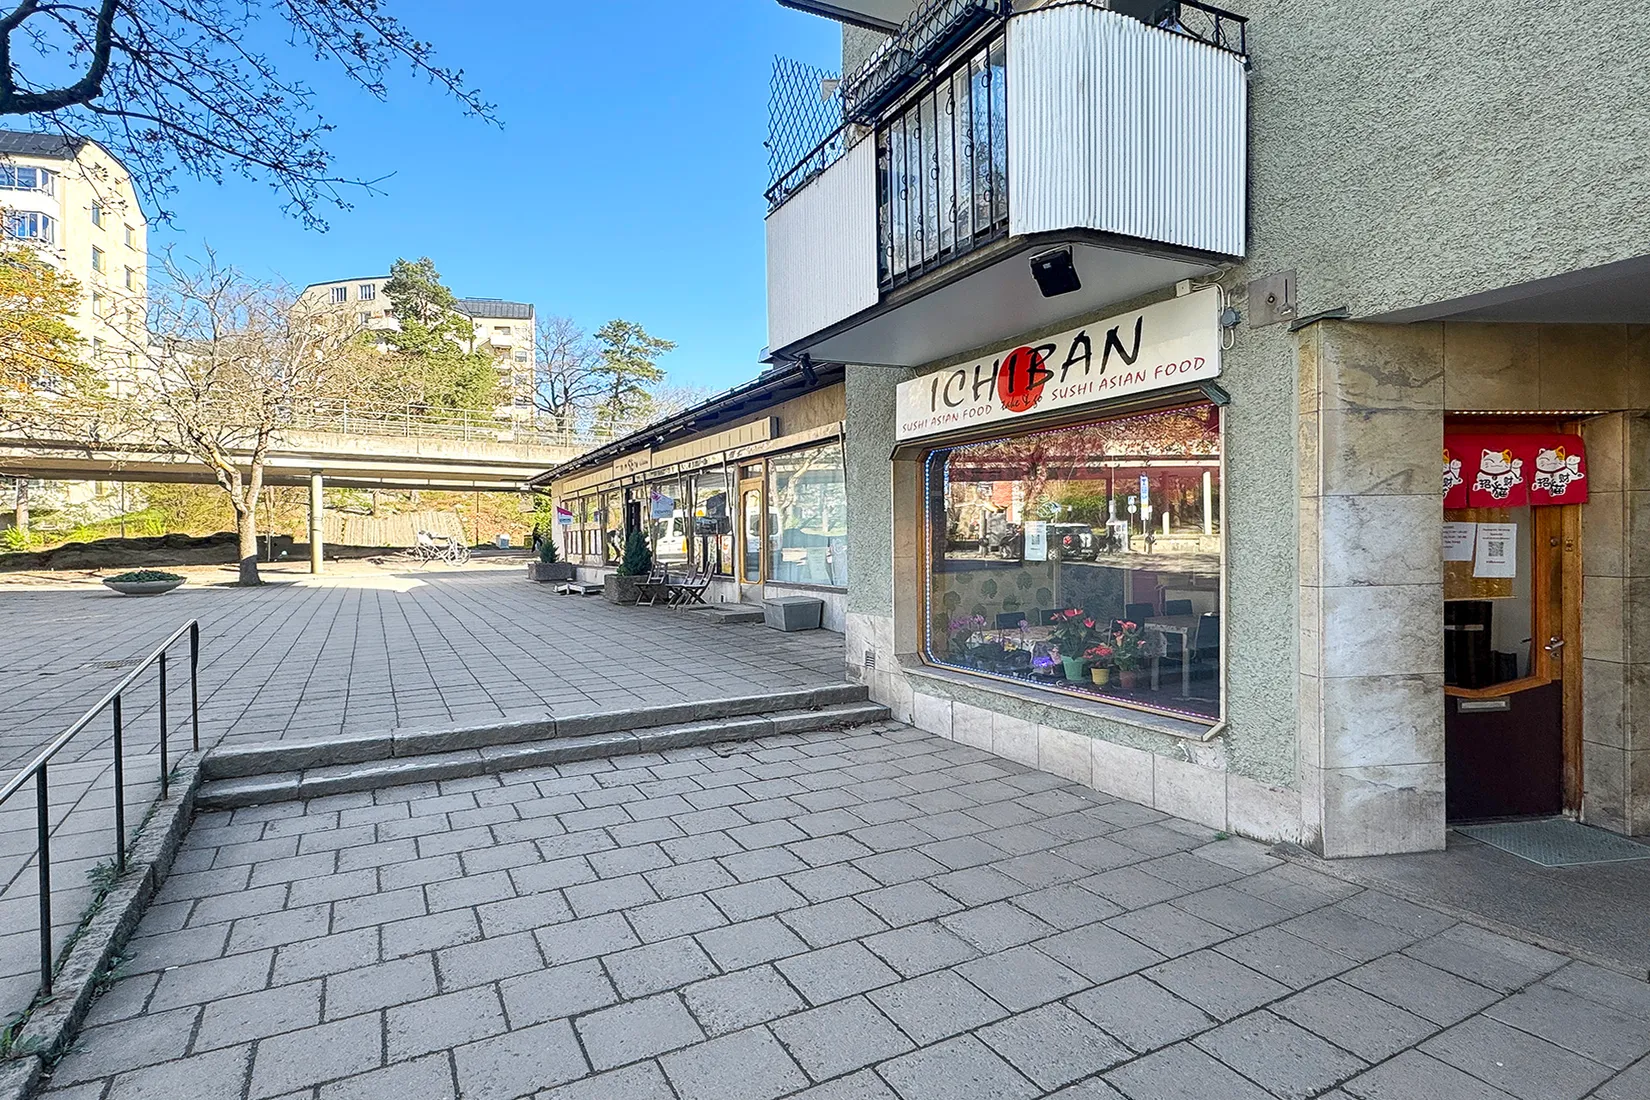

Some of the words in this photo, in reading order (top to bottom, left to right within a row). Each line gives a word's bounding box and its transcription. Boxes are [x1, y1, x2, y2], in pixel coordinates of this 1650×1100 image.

[930, 316, 1144, 413] ICHIBAN
[1051, 382, 1094, 401] SUSHI
[1098, 369, 1147, 391] ASIAN
[1154, 356, 1206, 380] FOOD
[902, 418, 928, 433] SUSHI
[930, 412, 959, 428] ASIAN
[962, 404, 993, 421] FOOD
[1000, 395, 1019, 411] take
[1033, 394, 1043, 409] go
